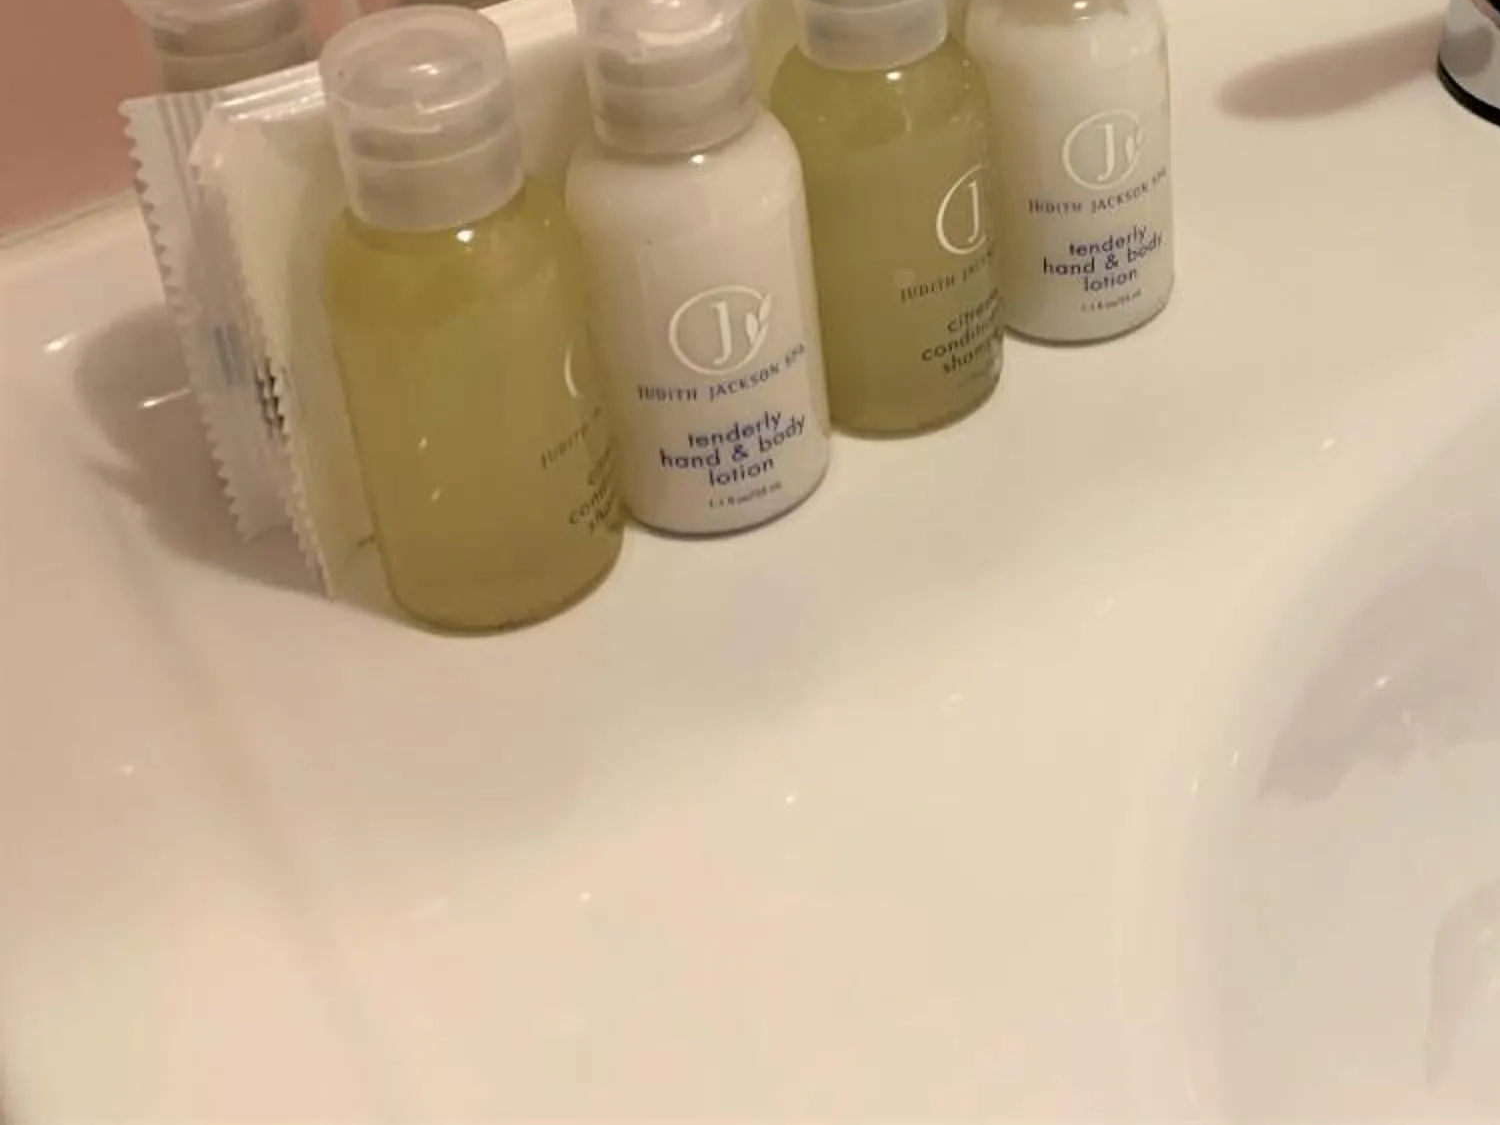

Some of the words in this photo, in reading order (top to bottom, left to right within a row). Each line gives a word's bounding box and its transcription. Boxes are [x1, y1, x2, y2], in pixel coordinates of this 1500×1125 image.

[1028, 197, 1083, 215] JUDITH
[1090, 181, 1149, 214] JACKSON
[1042, 255, 1096, 276] hand
[1105, 253, 1120, 270] &
[1127, 229, 1163, 264] body
[1069, 222, 1148, 257] tenderly
[1083, 268, 1138, 293] lotion
[636, 383, 698, 403] JUDITH
[708, 362, 781, 403] JACKSON
[659, 446, 721, 469] hand
[731, 443, 749, 463] &
[758, 413, 806, 453] body
[687, 410, 782, 448] tenderly
[708, 457, 775, 488] lotion
